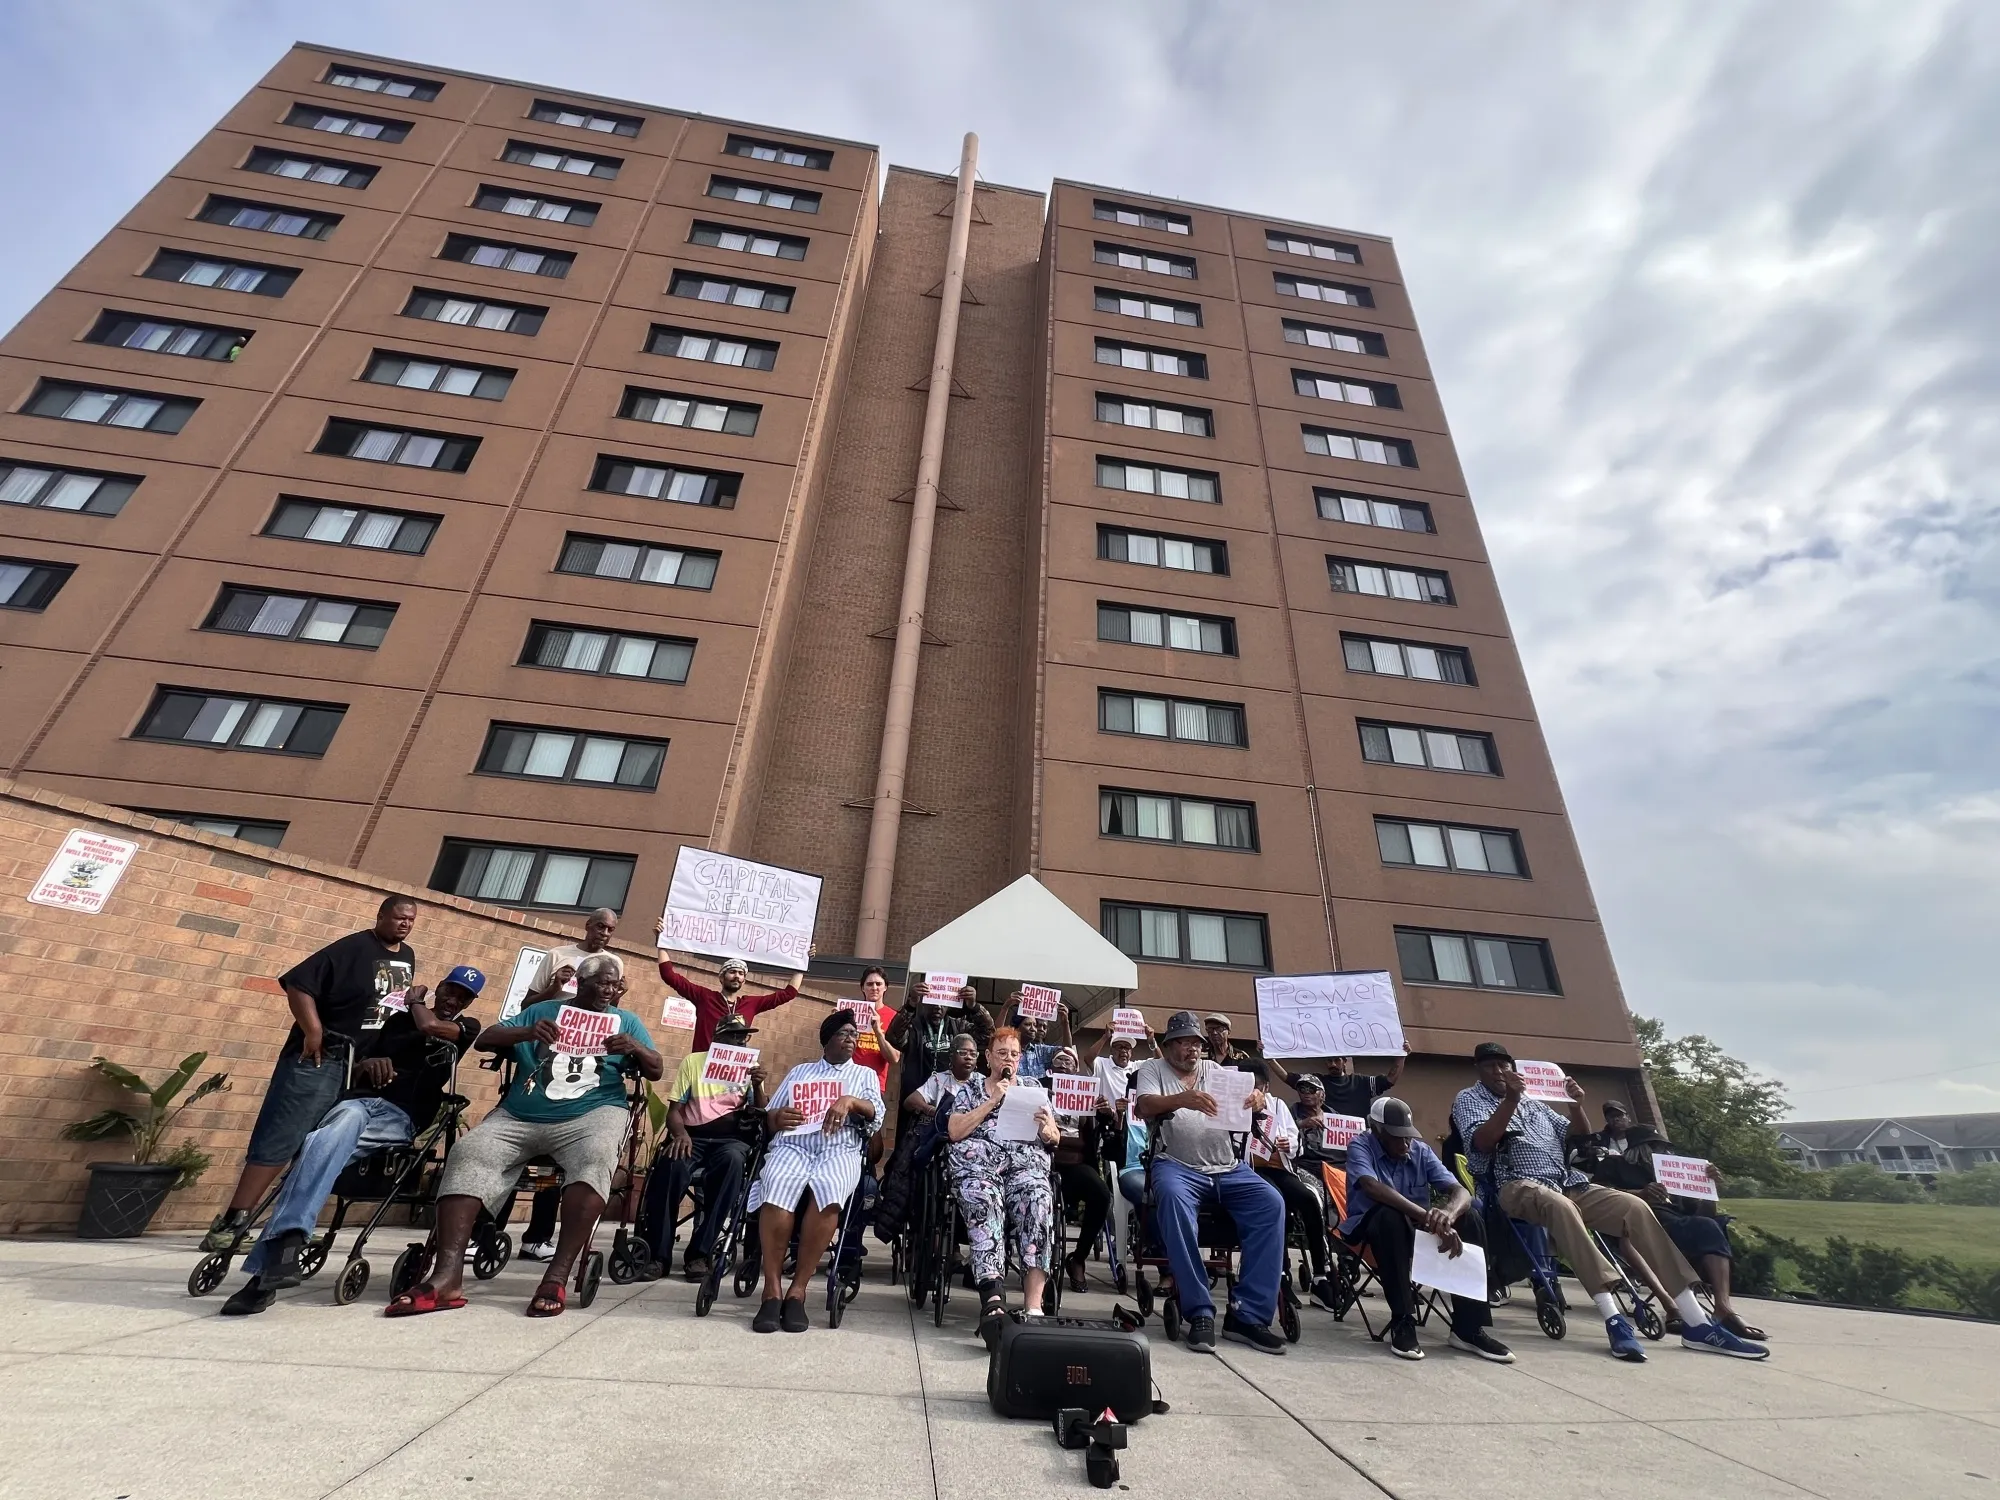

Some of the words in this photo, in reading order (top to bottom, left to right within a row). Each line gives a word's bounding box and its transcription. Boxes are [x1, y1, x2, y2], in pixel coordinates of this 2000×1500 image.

[65, 848, 81, 857] WILL
[81, 850, 91, 859] BE
[91, 852, 115, 865] TOWED
[114, 858, 124, 866] TO
[83, 845, 114, 857] VEHICLES
[693, 858, 800, 902] CAPITAL
[40, 888, 100, 907] 313-595-1771
[705, 889, 792, 933] REALTY
[666, 913, 736, 946] WHAT
[736, 922, 766, 953] UP
[766, 928, 808, 960] DOE
[463, 969, 478, 982] KC
[1024, 986, 1057, 1002] CAPITAL
[1271, 980, 1384, 1008] Power
[669, 1005, 693, 1015] SMOKING
[1022, 998, 1056, 1013] REALITY
[1295, 1007, 1312, 1019] to
[560, 1008, 614, 1035] CAPITAL
[556, 1043, 574, 1054] WHAT
[575, 1047, 585, 1056] UP
[712, 1047, 733, 1061] THAT
[734, 1051, 755, 1064] AIN'T
[705, 1062, 750, 1084] RIGHT!
[1523, 1066, 1541, 1075] RIVER
[793, 1081, 842, 1101] CAPITAL
[1056, 1078, 1076, 1090] THAT
[1077, 1080, 1097, 1092] AIN'T
[1545, 1079, 1565, 1088] TENANT
[1055, 1091, 1096, 1112] RIGHT!
[1326, 1117, 1344, 1128] THAT
[1345, 1120, 1363, 1130] AIN'T
[1326, 1129, 1358, 1147] RIGH
[1661, 1159, 1680, 1168] RIVER
[1681, 1162, 1705, 1172] POINTE
[1658, 1169, 1685, 1179] TOWERS
[1686, 1173, 1710, 1184] TENANT
[1682, 1183, 1712, 1194] MEMBER
[1066, 1365, 1092, 1385] JBL
